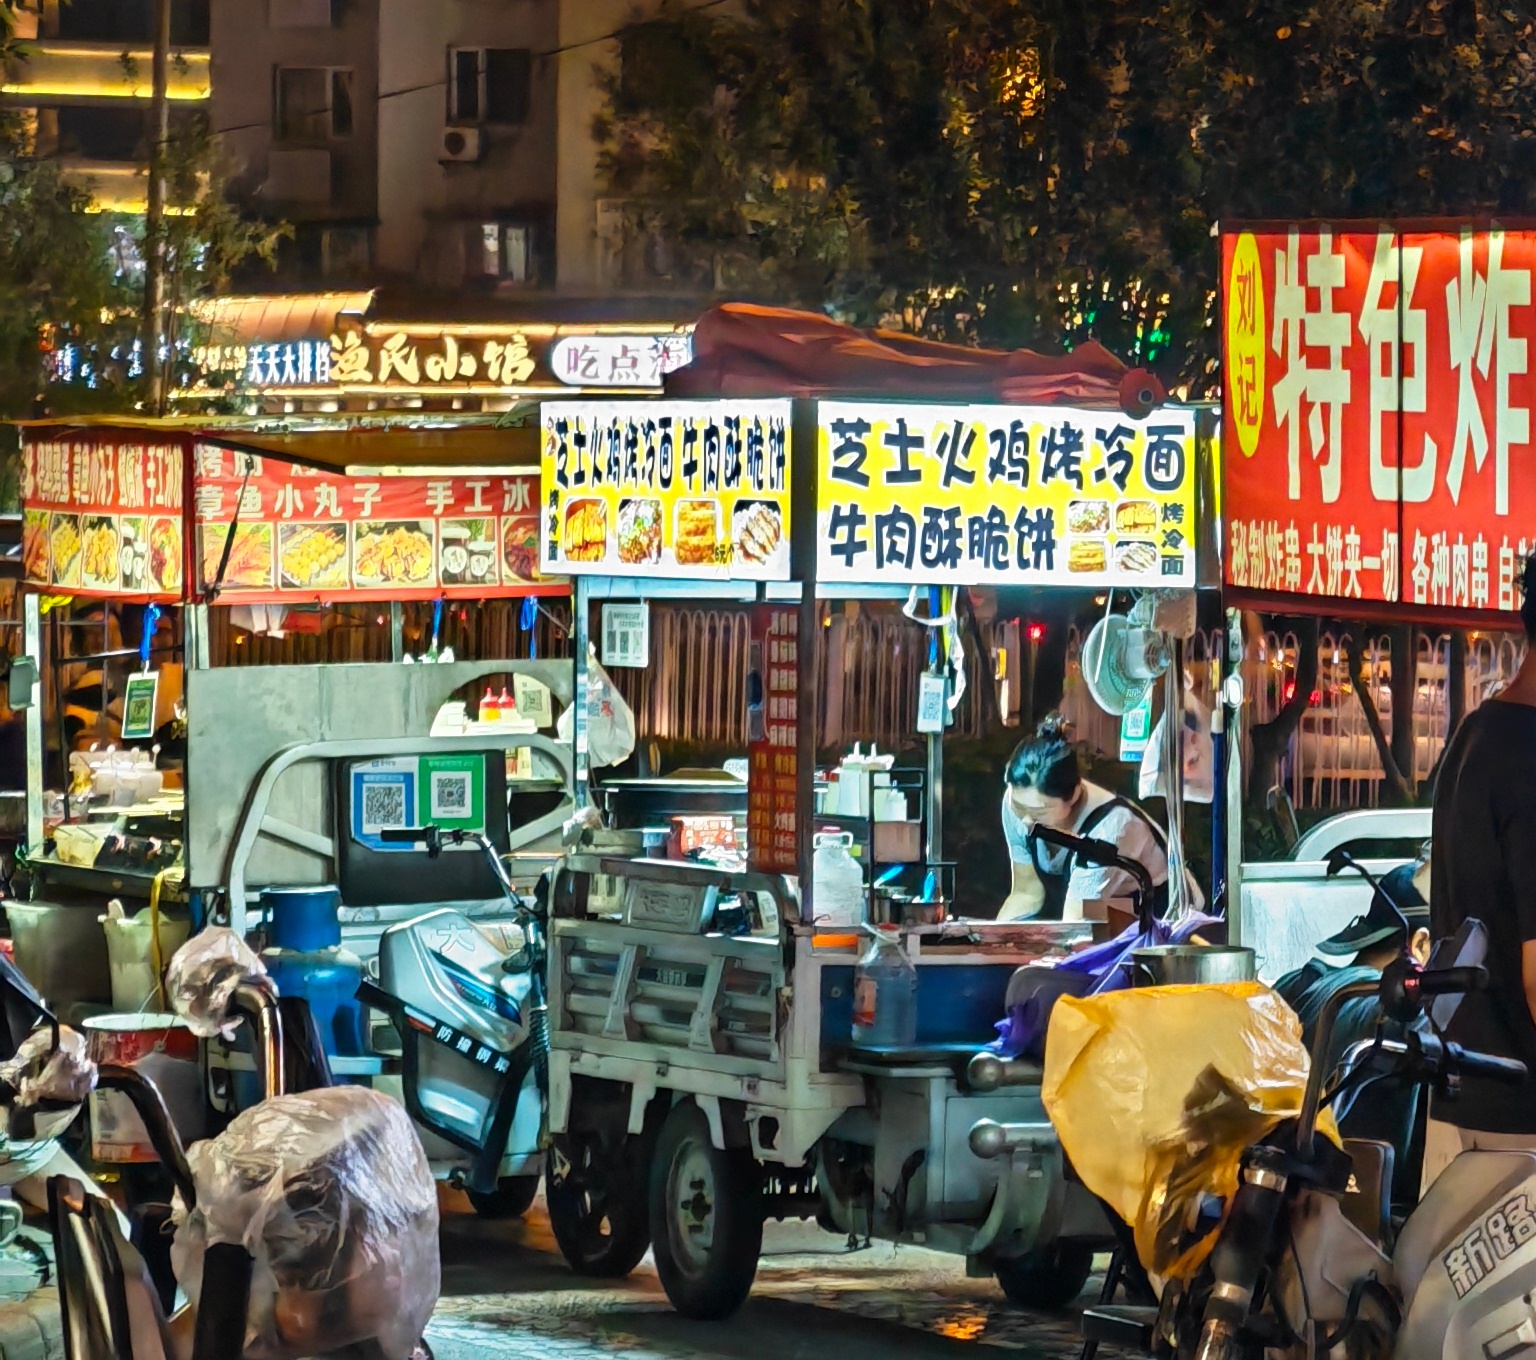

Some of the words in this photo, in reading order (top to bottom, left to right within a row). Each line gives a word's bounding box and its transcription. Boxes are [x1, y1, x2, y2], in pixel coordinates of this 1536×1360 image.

[249, 341, 331, 384] 天天大排档
[330, 330, 535, 384] 渔民小馆
[1235, 256, 1260, 427] 刘记
[830, 416, 1186, 493] 芝士火鸡烤冷面
[195, 482, 383, 521] 章鱼小丸子
[827, 502, 1056, 571] 牛肉酥脆饼
[1160, 501, 1185, 576] 烤冷面
[1230, 518, 1301, 592] 秘制炸串
[1306, 521, 1399, 603] 大饼夹一切
[1411, 528, 1489, 610] 各种肉串
